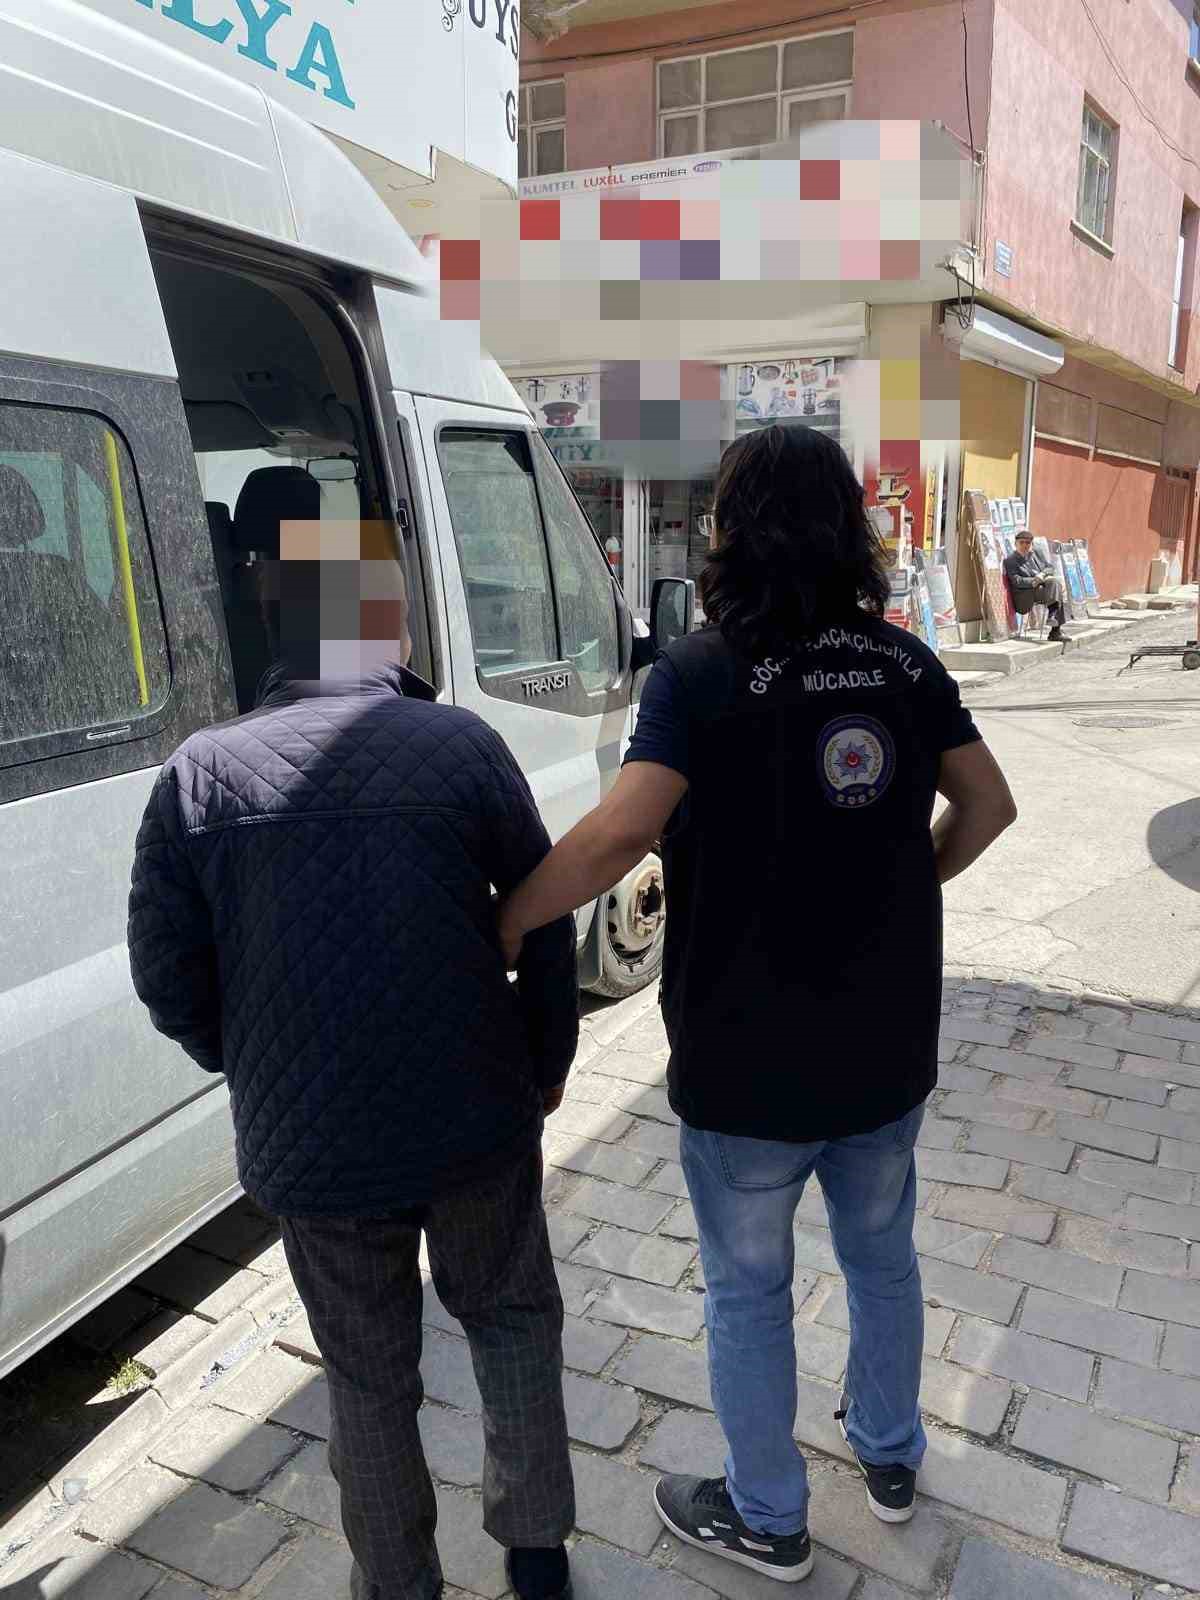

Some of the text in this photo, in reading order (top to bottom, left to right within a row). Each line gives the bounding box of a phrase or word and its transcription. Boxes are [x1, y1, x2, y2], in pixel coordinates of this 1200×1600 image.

[134, 0, 354, 109] LYA
[523, 180, 576, 195] KUMTEL
[583, 174, 625, 188] LUXELL
[521, 672, 571, 697] TRANSIT
[803, 669, 886, 692] MÜCADELE
